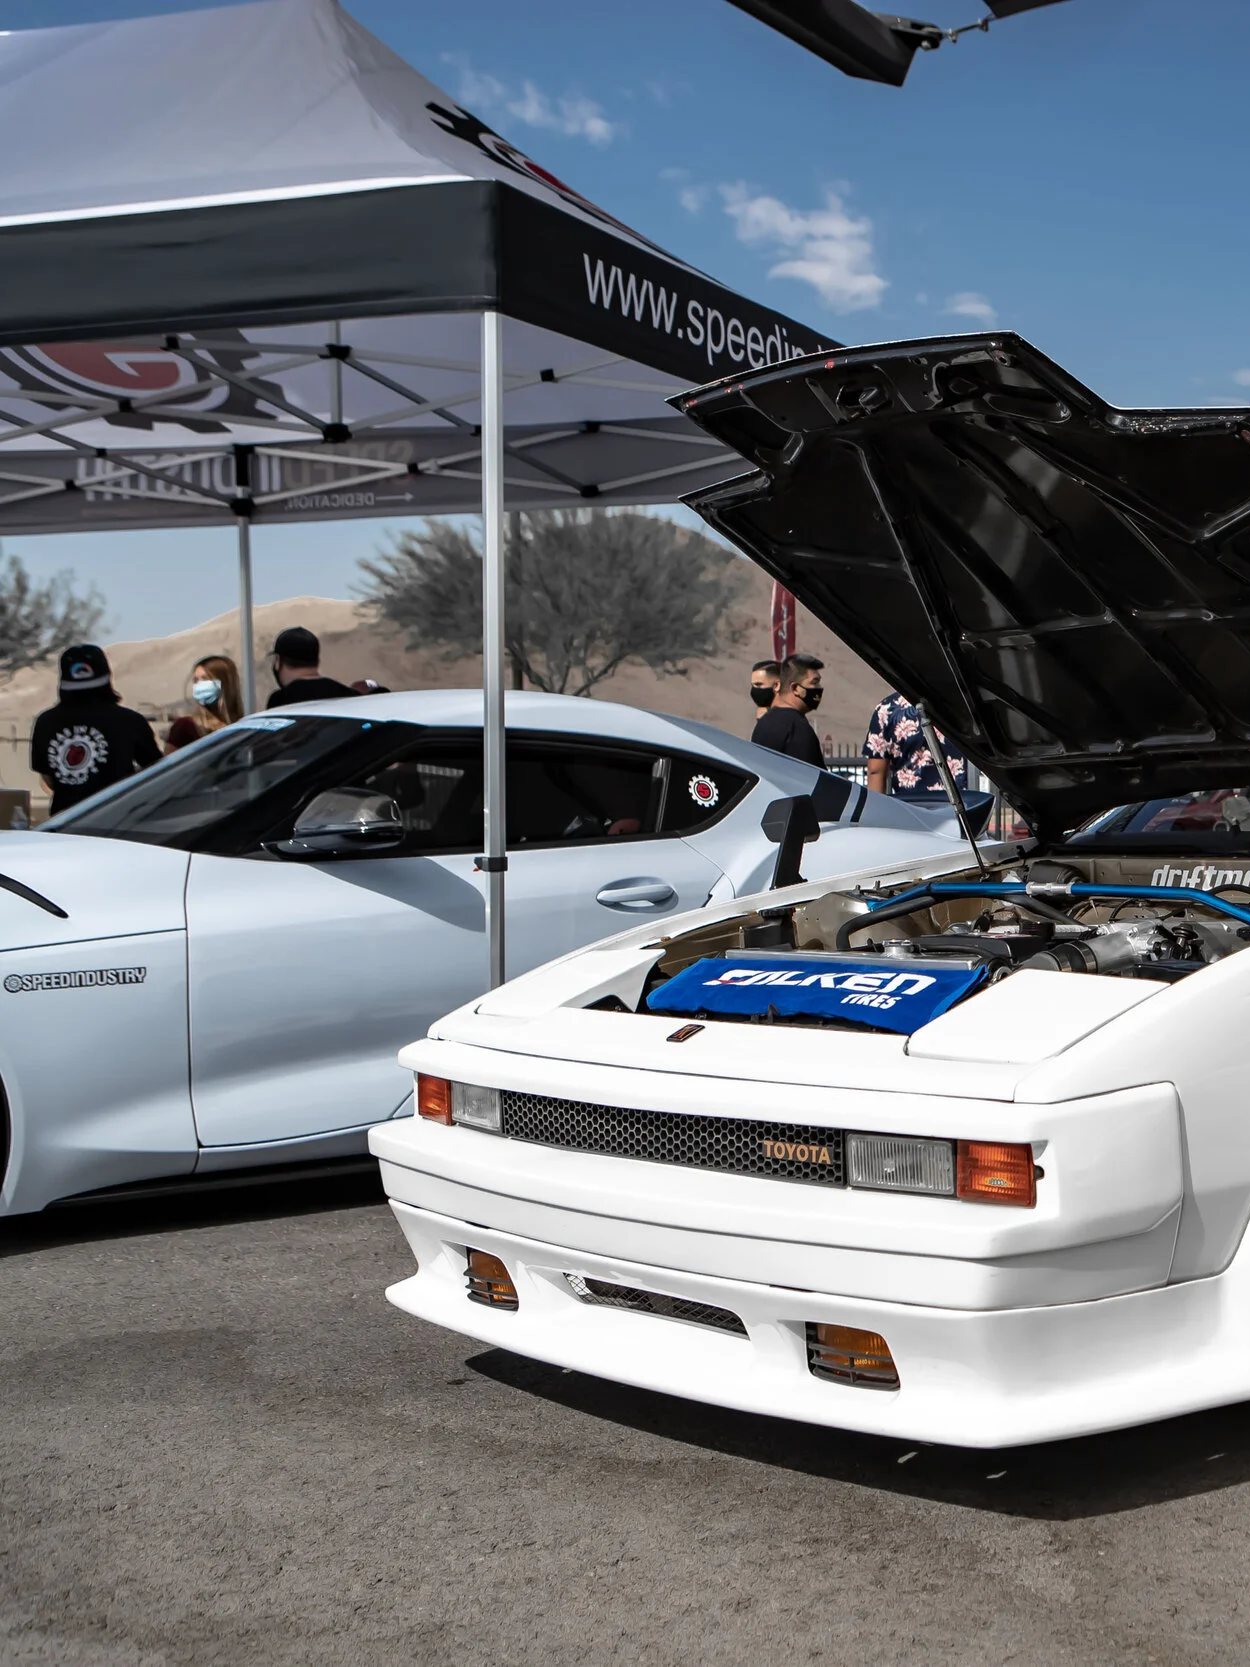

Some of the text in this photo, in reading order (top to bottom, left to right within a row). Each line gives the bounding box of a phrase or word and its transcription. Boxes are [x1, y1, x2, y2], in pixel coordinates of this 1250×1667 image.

[702, 969, 937, 997] FALKEN
[840, 992, 903, 1010] TIRES
[763, 1140, 832, 1165] TOYOTA
